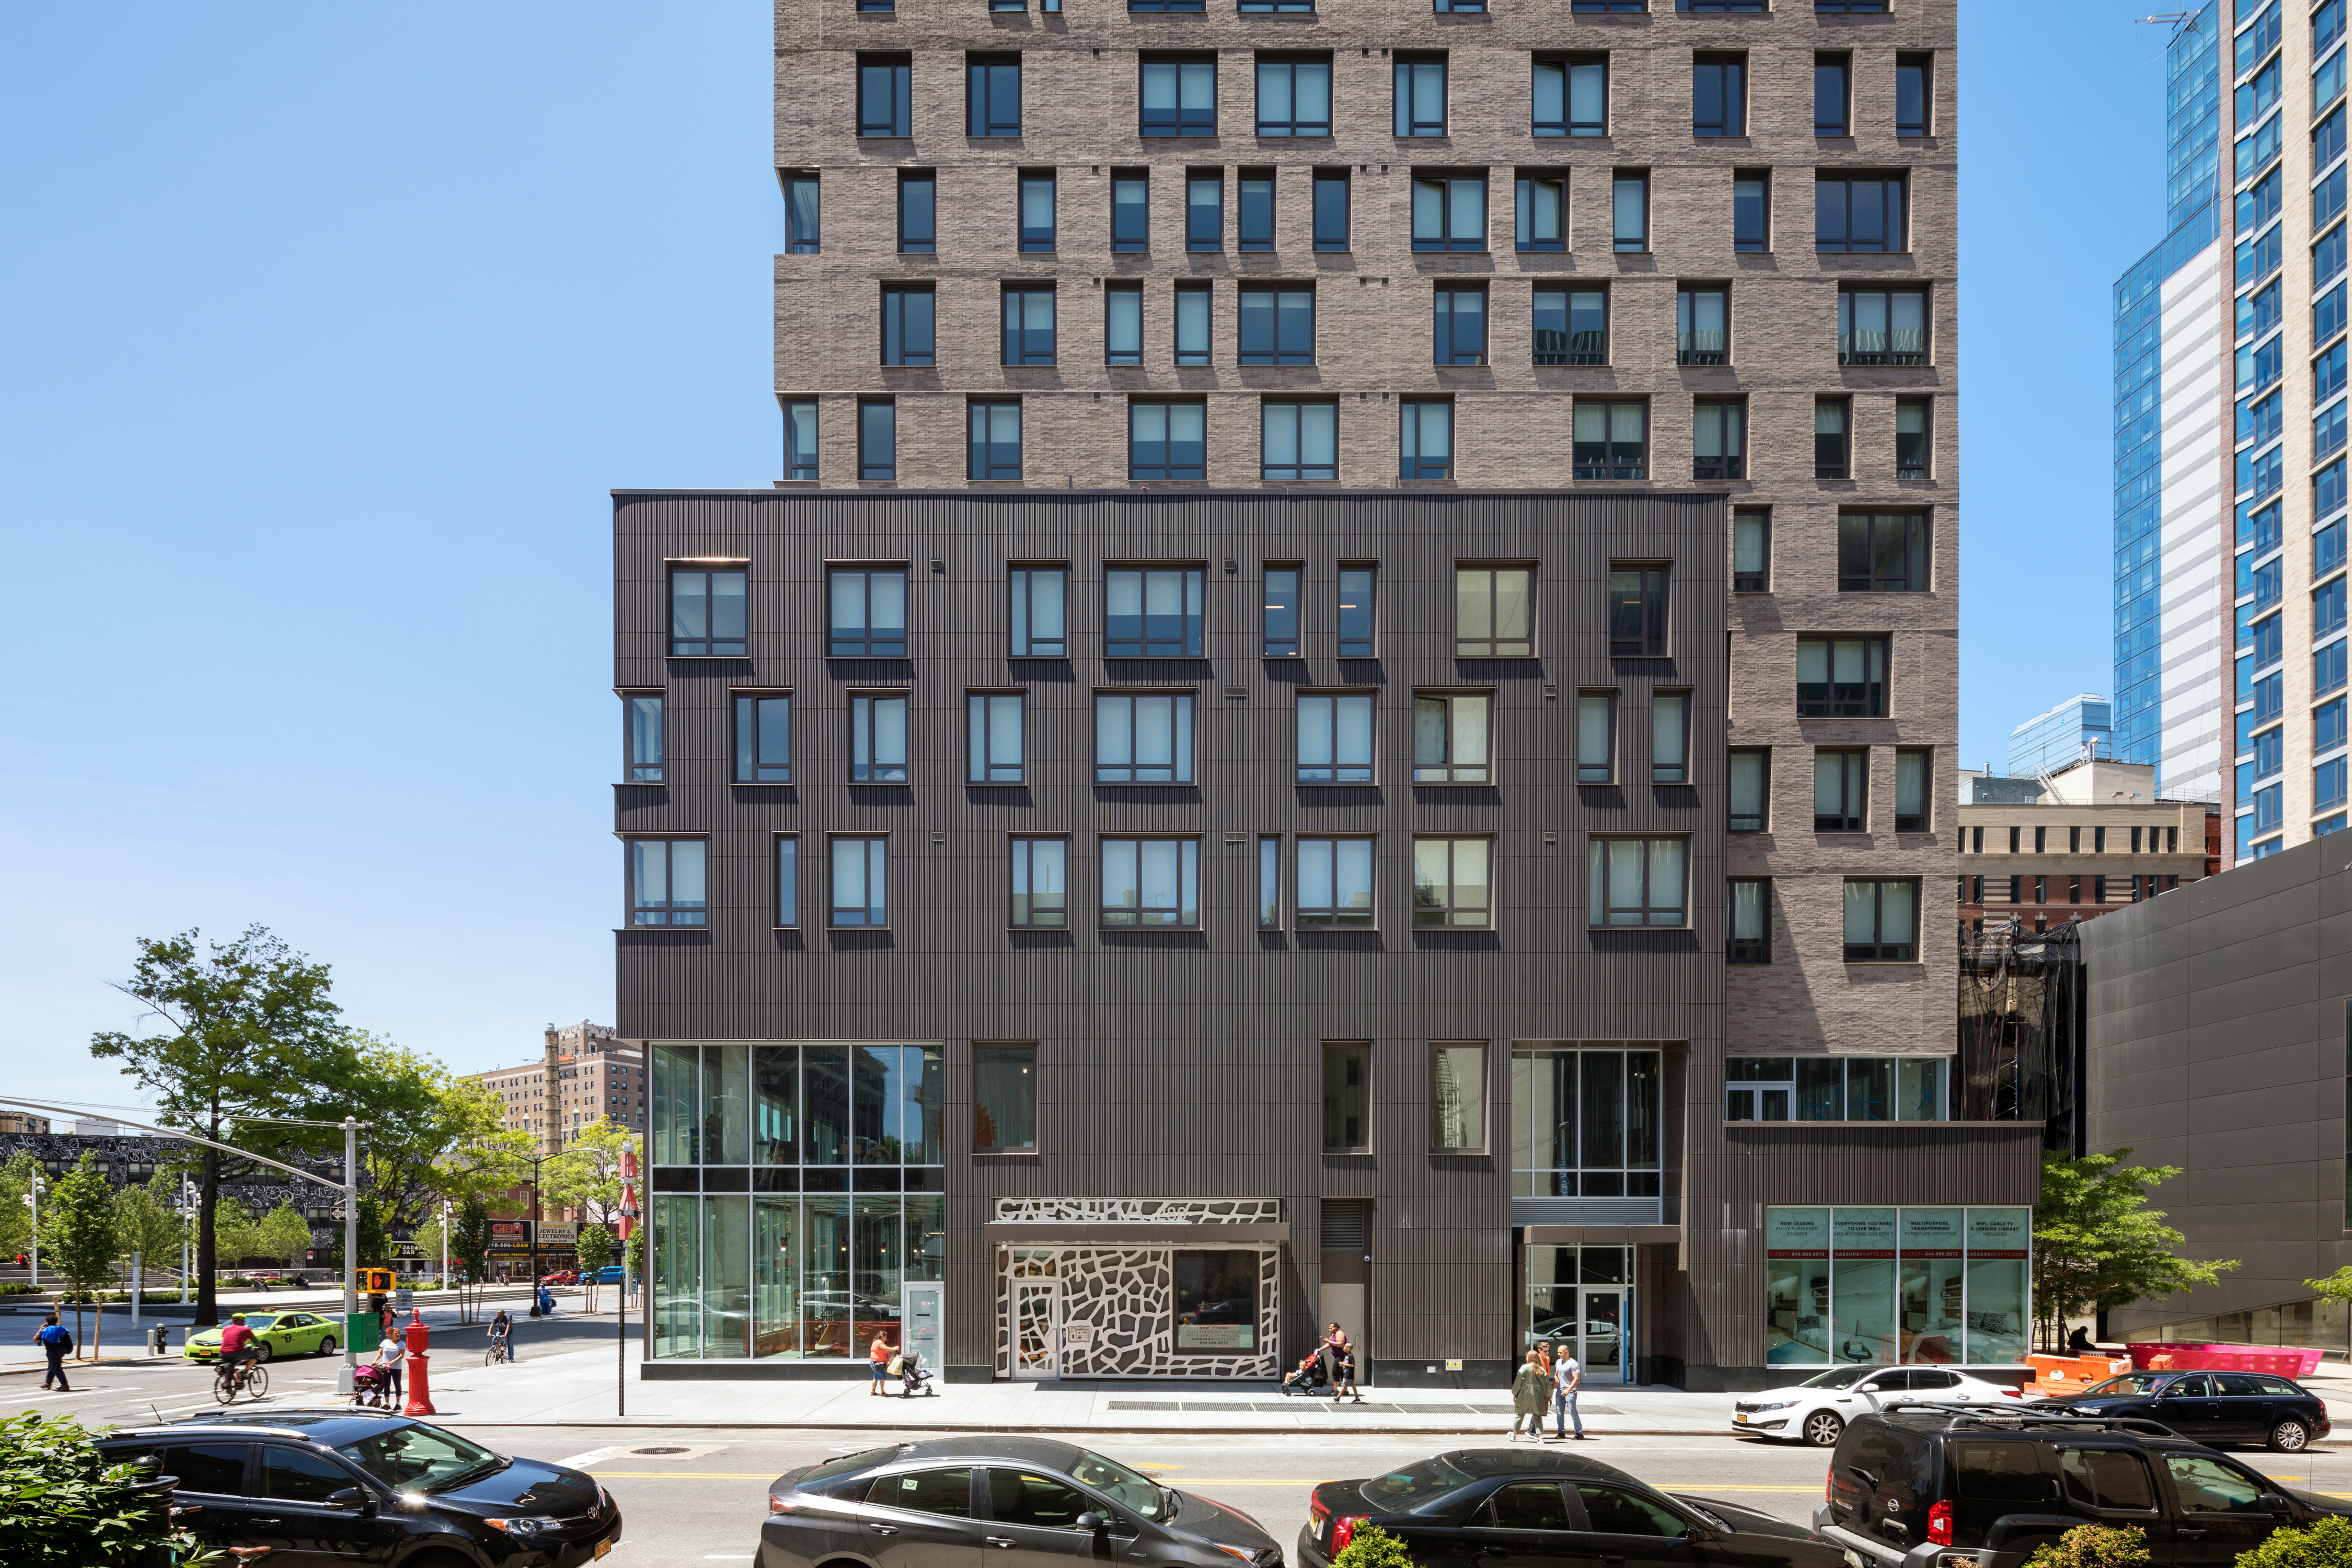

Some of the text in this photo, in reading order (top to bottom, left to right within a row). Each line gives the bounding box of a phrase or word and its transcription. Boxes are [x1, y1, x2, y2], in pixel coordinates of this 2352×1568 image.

[996, 1198, 1187, 1221] CAESURA 280
[492, 1224, 523, 1233] GEM
